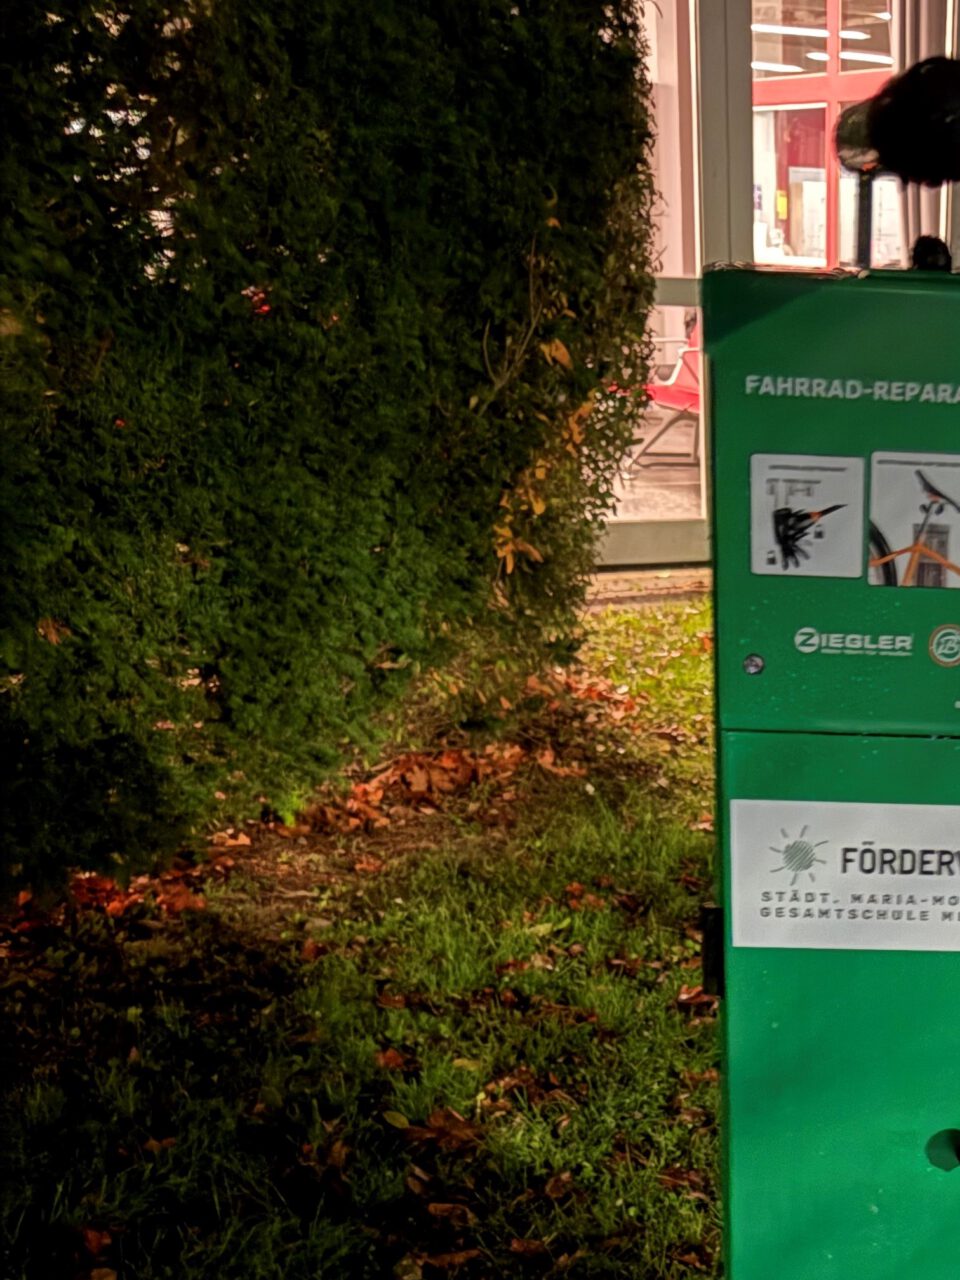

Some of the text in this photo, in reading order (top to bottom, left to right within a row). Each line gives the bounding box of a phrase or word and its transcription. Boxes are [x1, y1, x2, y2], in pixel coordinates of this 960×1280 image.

[794, 627, 913, 653] ZIEGLER
[761, 889, 840, 905] STÄDT.
[760, 907, 930, 921] GESAMTSCHULE
